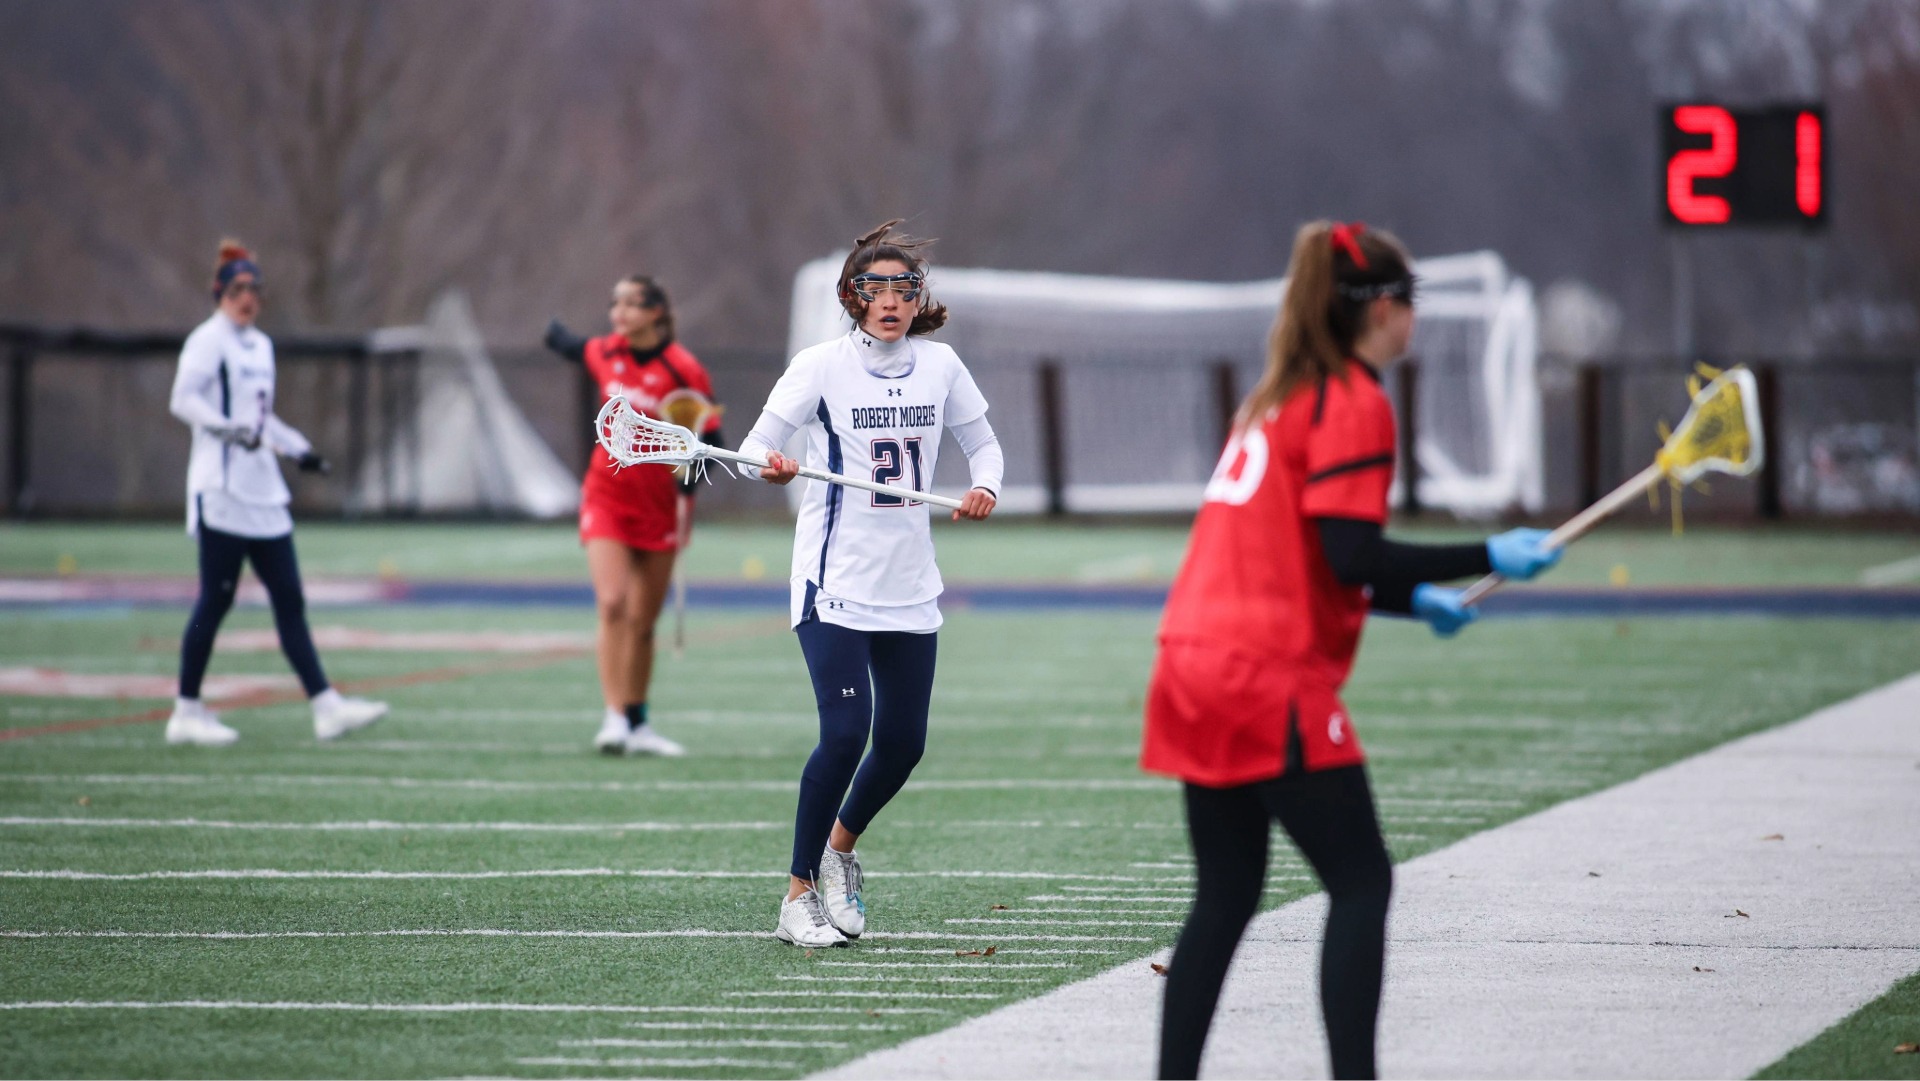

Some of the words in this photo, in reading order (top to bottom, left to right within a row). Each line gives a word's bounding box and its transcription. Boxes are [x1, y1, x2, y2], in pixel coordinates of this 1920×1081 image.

[1667, 105, 1822, 224] 21
[852, 407, 896, 429] ROBERT
[899, 405, 935, 427] MORRIS
[871, 437, 924, 507] 21
